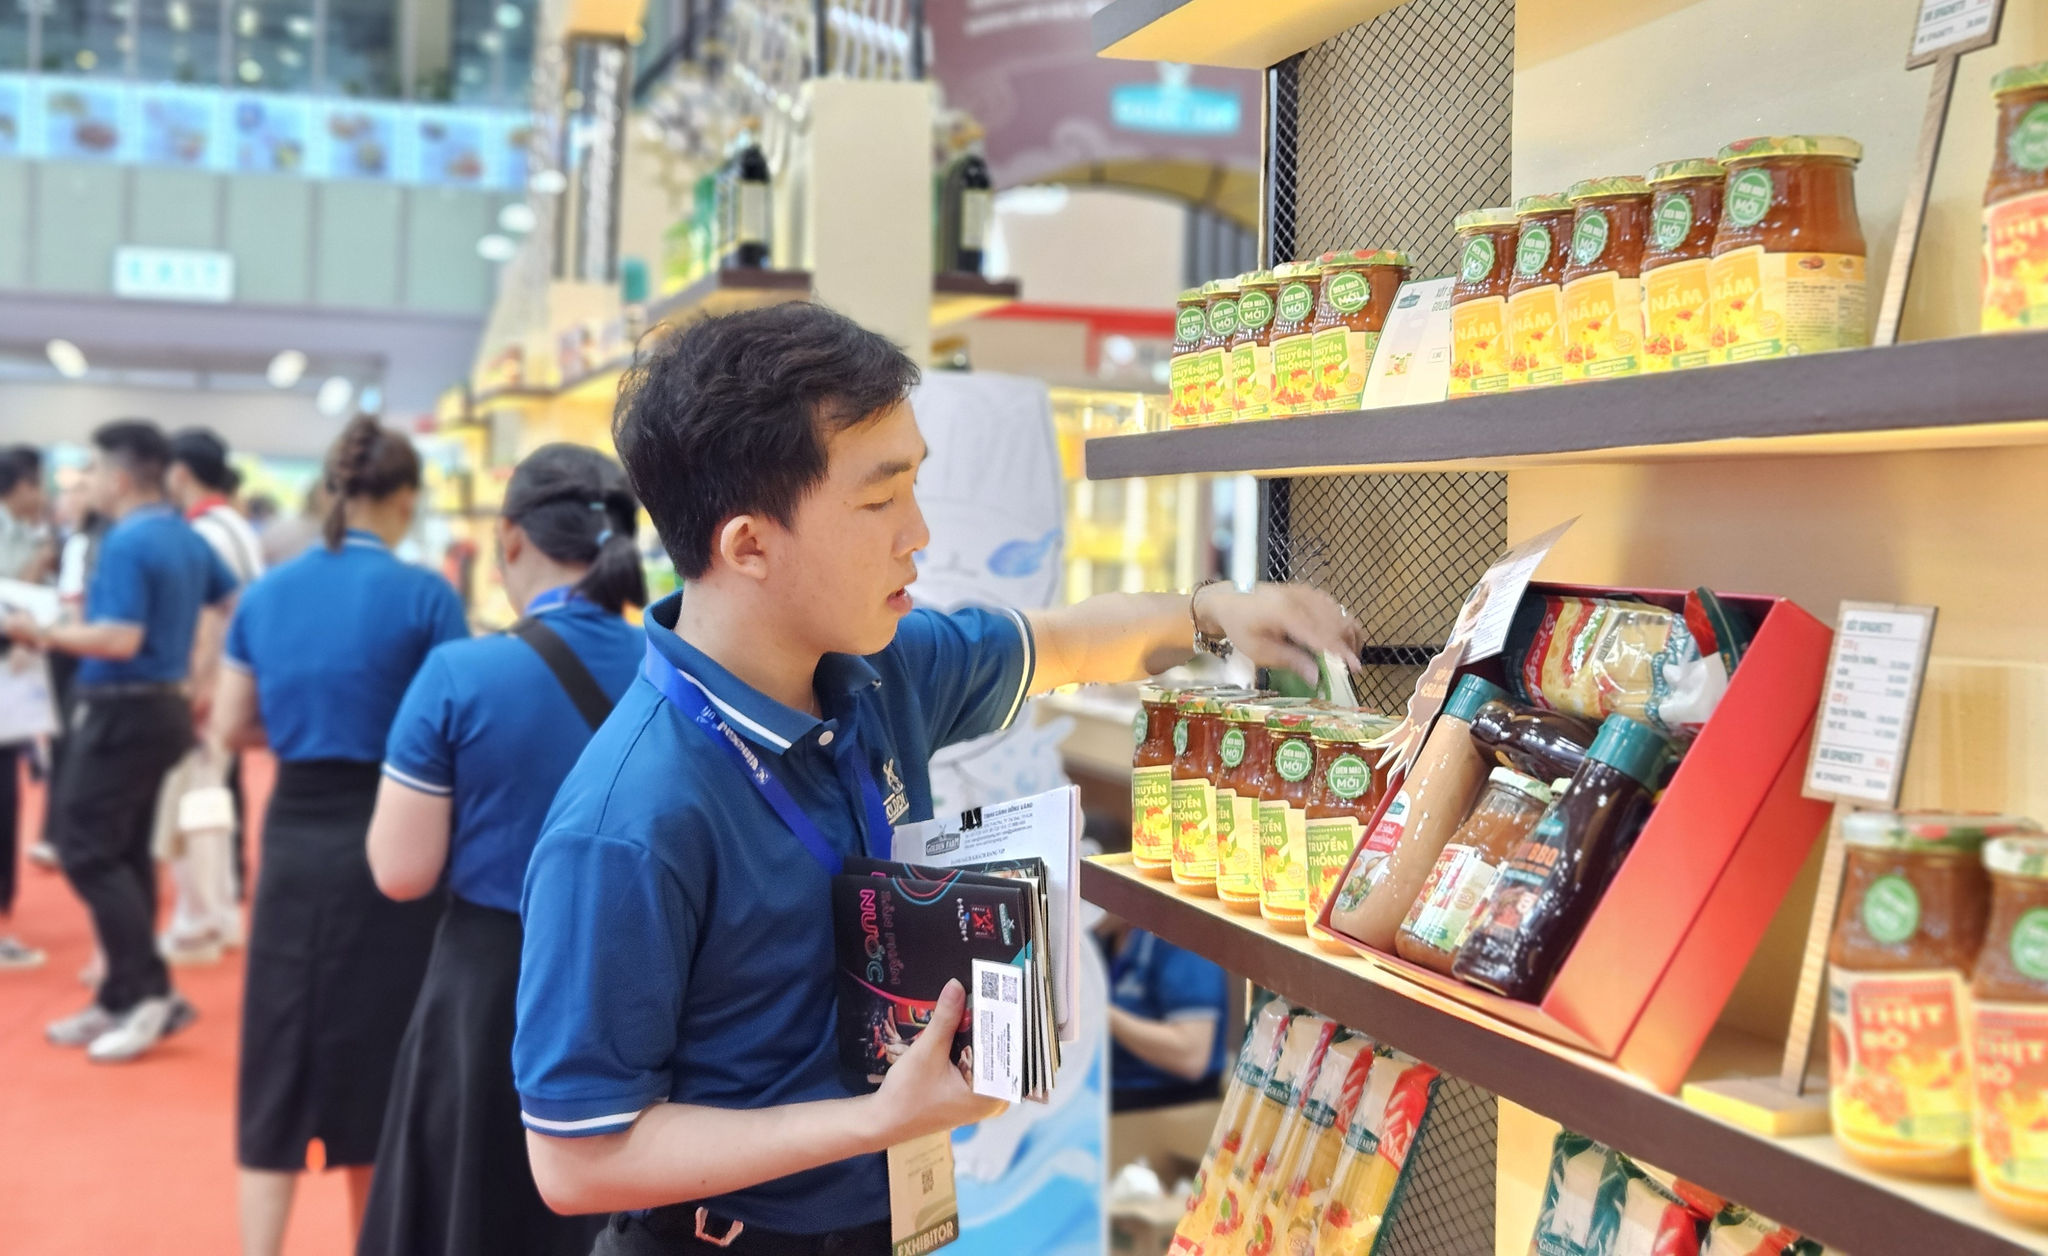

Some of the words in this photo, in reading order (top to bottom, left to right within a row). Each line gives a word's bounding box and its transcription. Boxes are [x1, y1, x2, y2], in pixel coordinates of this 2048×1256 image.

[1735, 198, 1758, 213] MỚI
[1661, 222, 1680, 237] MỚI
[1712, 270, 1755, 300] NẤM
[1651, 279, 1704, 313] NẤM
[1244, 308, 1265, 321] MỚI
[1285, 302, 1305, 315] MỚI
[1567, 297, 1611, 324] NẤM
[1215, 317, 1234, 329] MỚI
[1512, 308, 1552, 332] NẤM
[1182, 323, 1201, 335] MỚI
[1455, 317, 1497, 342] NẤM
[1225, 747, 1240, 759] MỚI
[1283, 758, 1303, 772] MỚI
[1336, 775, 1360, 789] MỚI
[1308, 836, 1349, 853] TRUYỀN
[1309, 852, 1349, 867] THỐNG
[1528, 842, 1559, 868] BBQ
[1265, 1085, 1290, 1100] GOLDEN
[1360, 1136, 1378, 1152] FARM
[897, 1220, 954, 1256] EXHIBITOR
